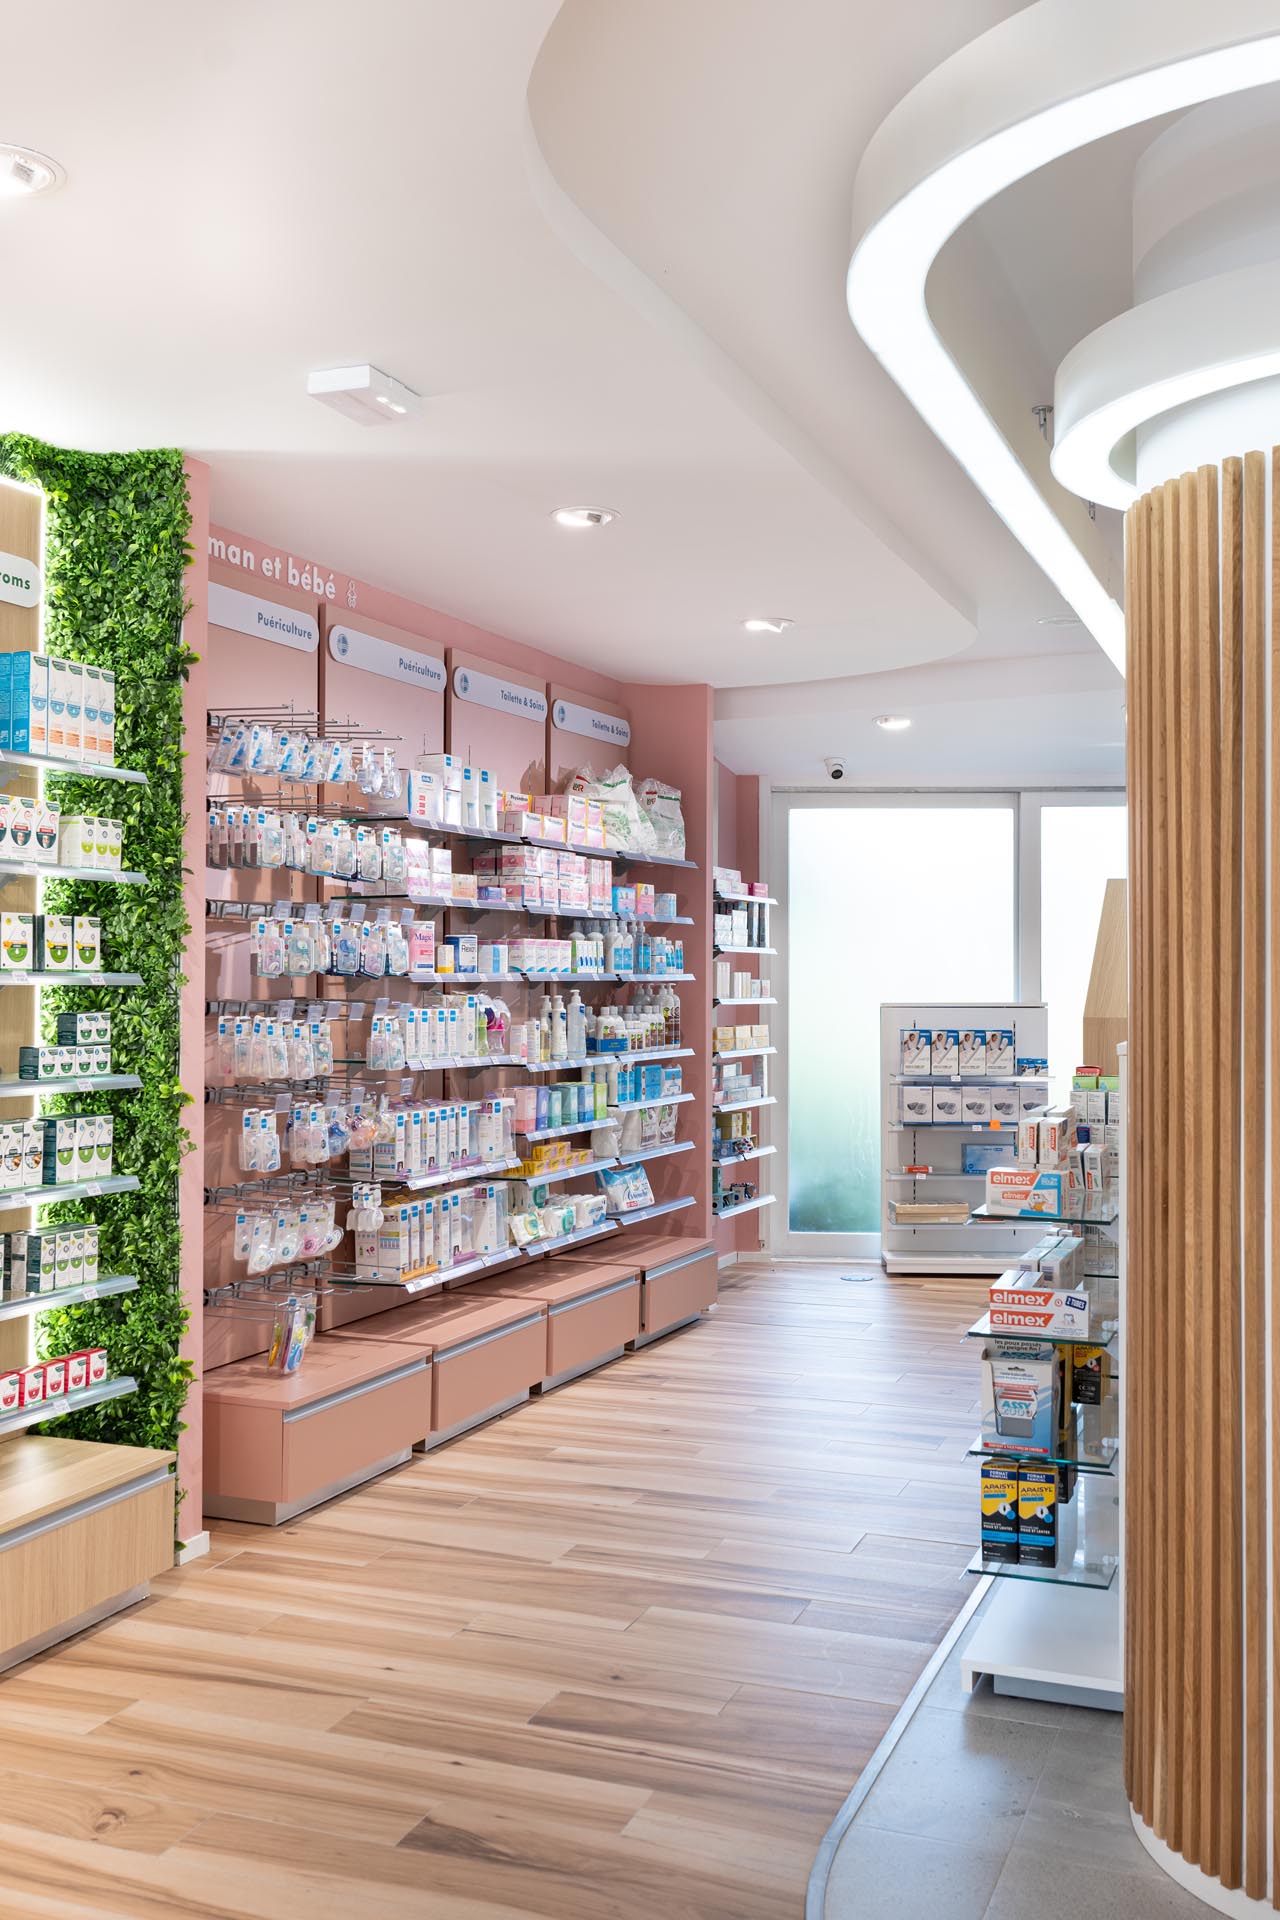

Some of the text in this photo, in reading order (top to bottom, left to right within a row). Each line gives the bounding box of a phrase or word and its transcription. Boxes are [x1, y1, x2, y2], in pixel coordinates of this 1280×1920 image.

[208, 536, 336, 600] man et bébé
[0, 571, 31, 590] oms
[257, 611, 313, 640] Puériculture
[399, 657, 441, 680] Puériculture
[501, 690, 522, 705] Toilette
[529, 698, 545, 711] Soins
[592, 719, 610, 733] Toilette
[993, 1173, 1030, 1184] elmex
[1003, 1192, 1025, 1200] elmex
[992, 1291, 1045, 1306] elmex
[992, 1311, 1045, 1327] elmex
